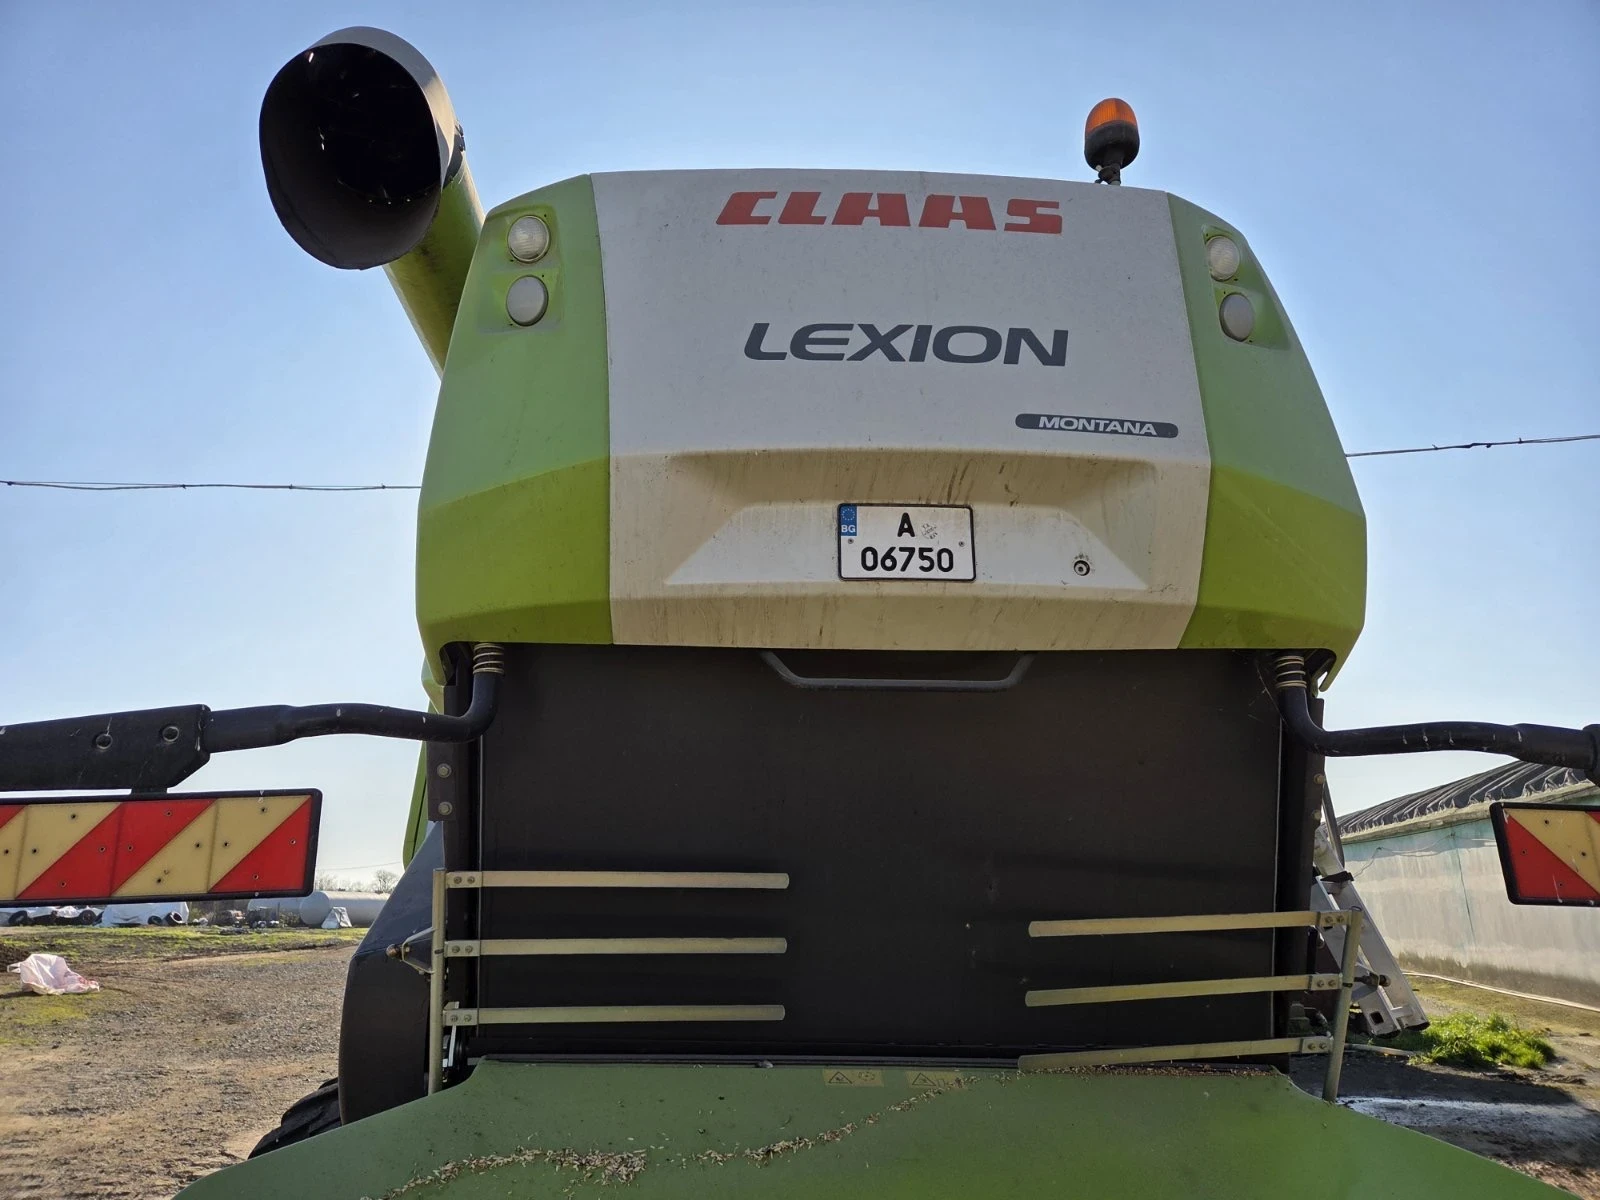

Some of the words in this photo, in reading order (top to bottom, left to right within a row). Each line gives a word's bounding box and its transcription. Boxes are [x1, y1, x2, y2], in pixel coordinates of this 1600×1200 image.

[716, 191, 1062, 234] CLAAS
[744, 323, 1068, 366] LEXION
[1038, 416, 1157, 436] MONTANA
[841, 525, 856, 533] BG
[897, 512, 915, 537] A
[861, 546, 954, 572] 06750
